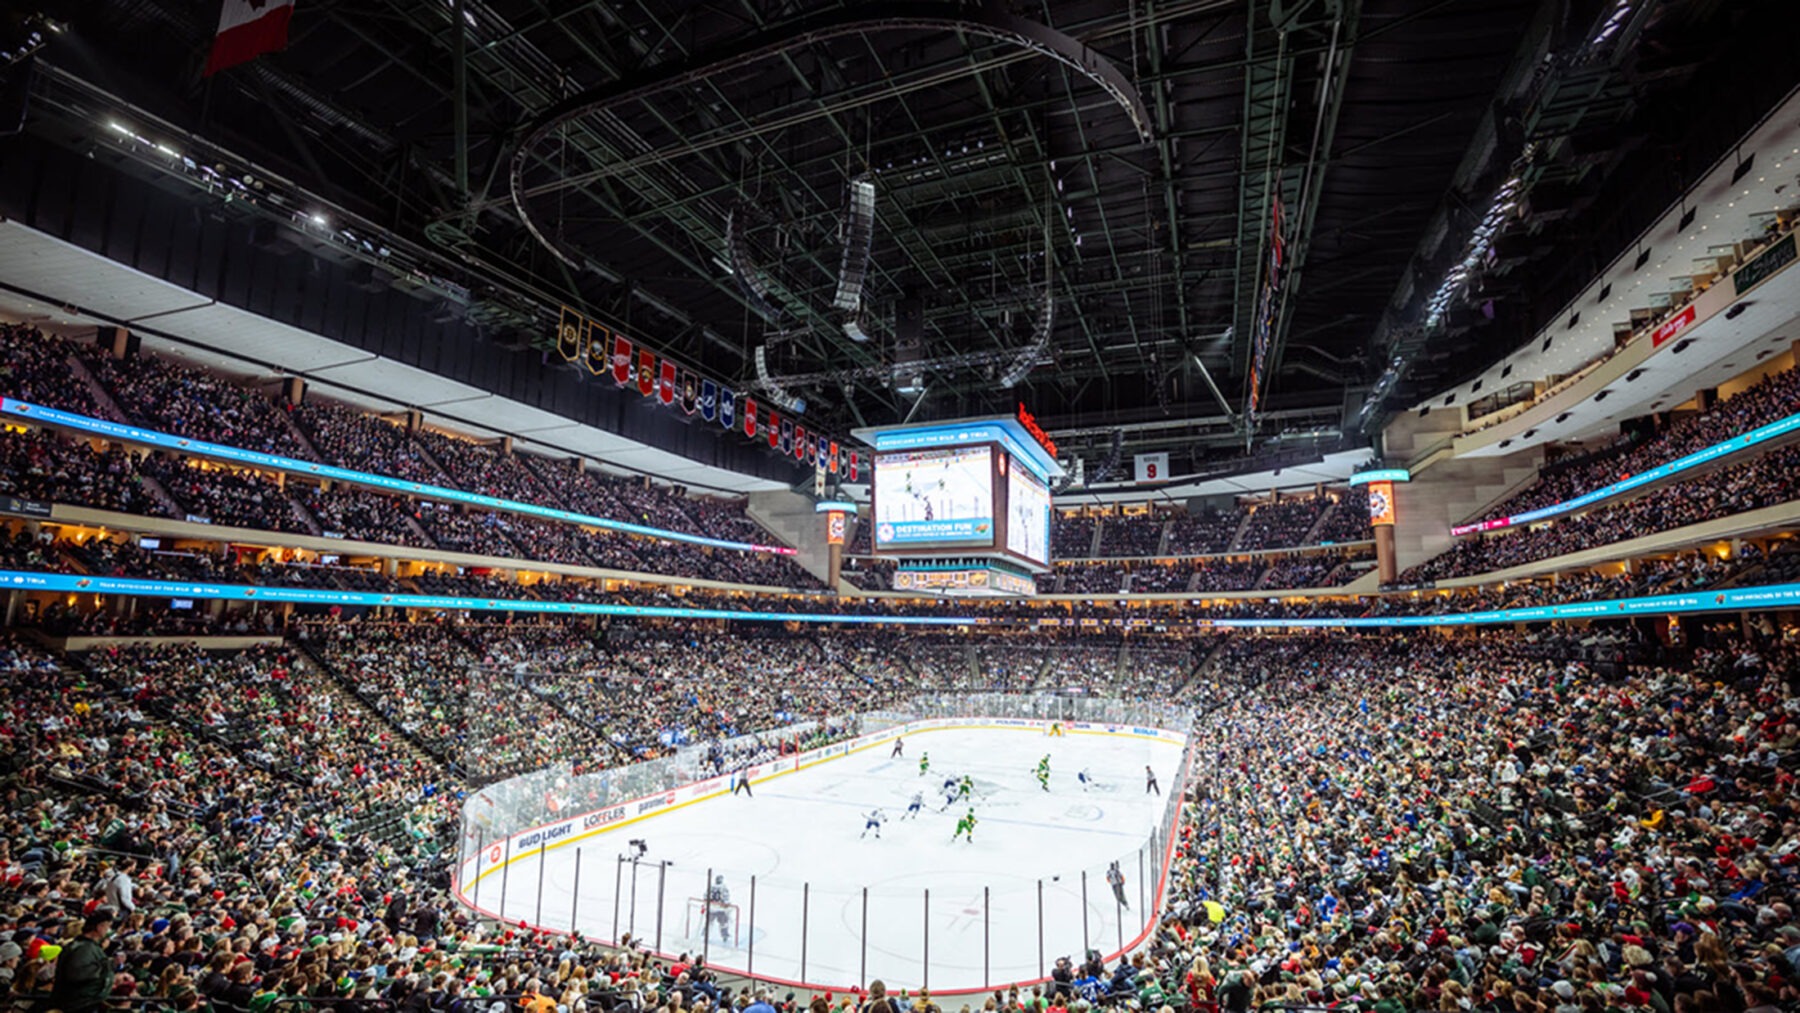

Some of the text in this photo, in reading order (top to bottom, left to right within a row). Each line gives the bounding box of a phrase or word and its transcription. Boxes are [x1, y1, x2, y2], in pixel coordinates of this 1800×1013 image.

[1147, 464, 1156, 479] 9
[954, 523, 972, 532] FUN
[584, 807, 625, 827] LOFFLER
[518, 824, 572, 849] BUD LIGHT
